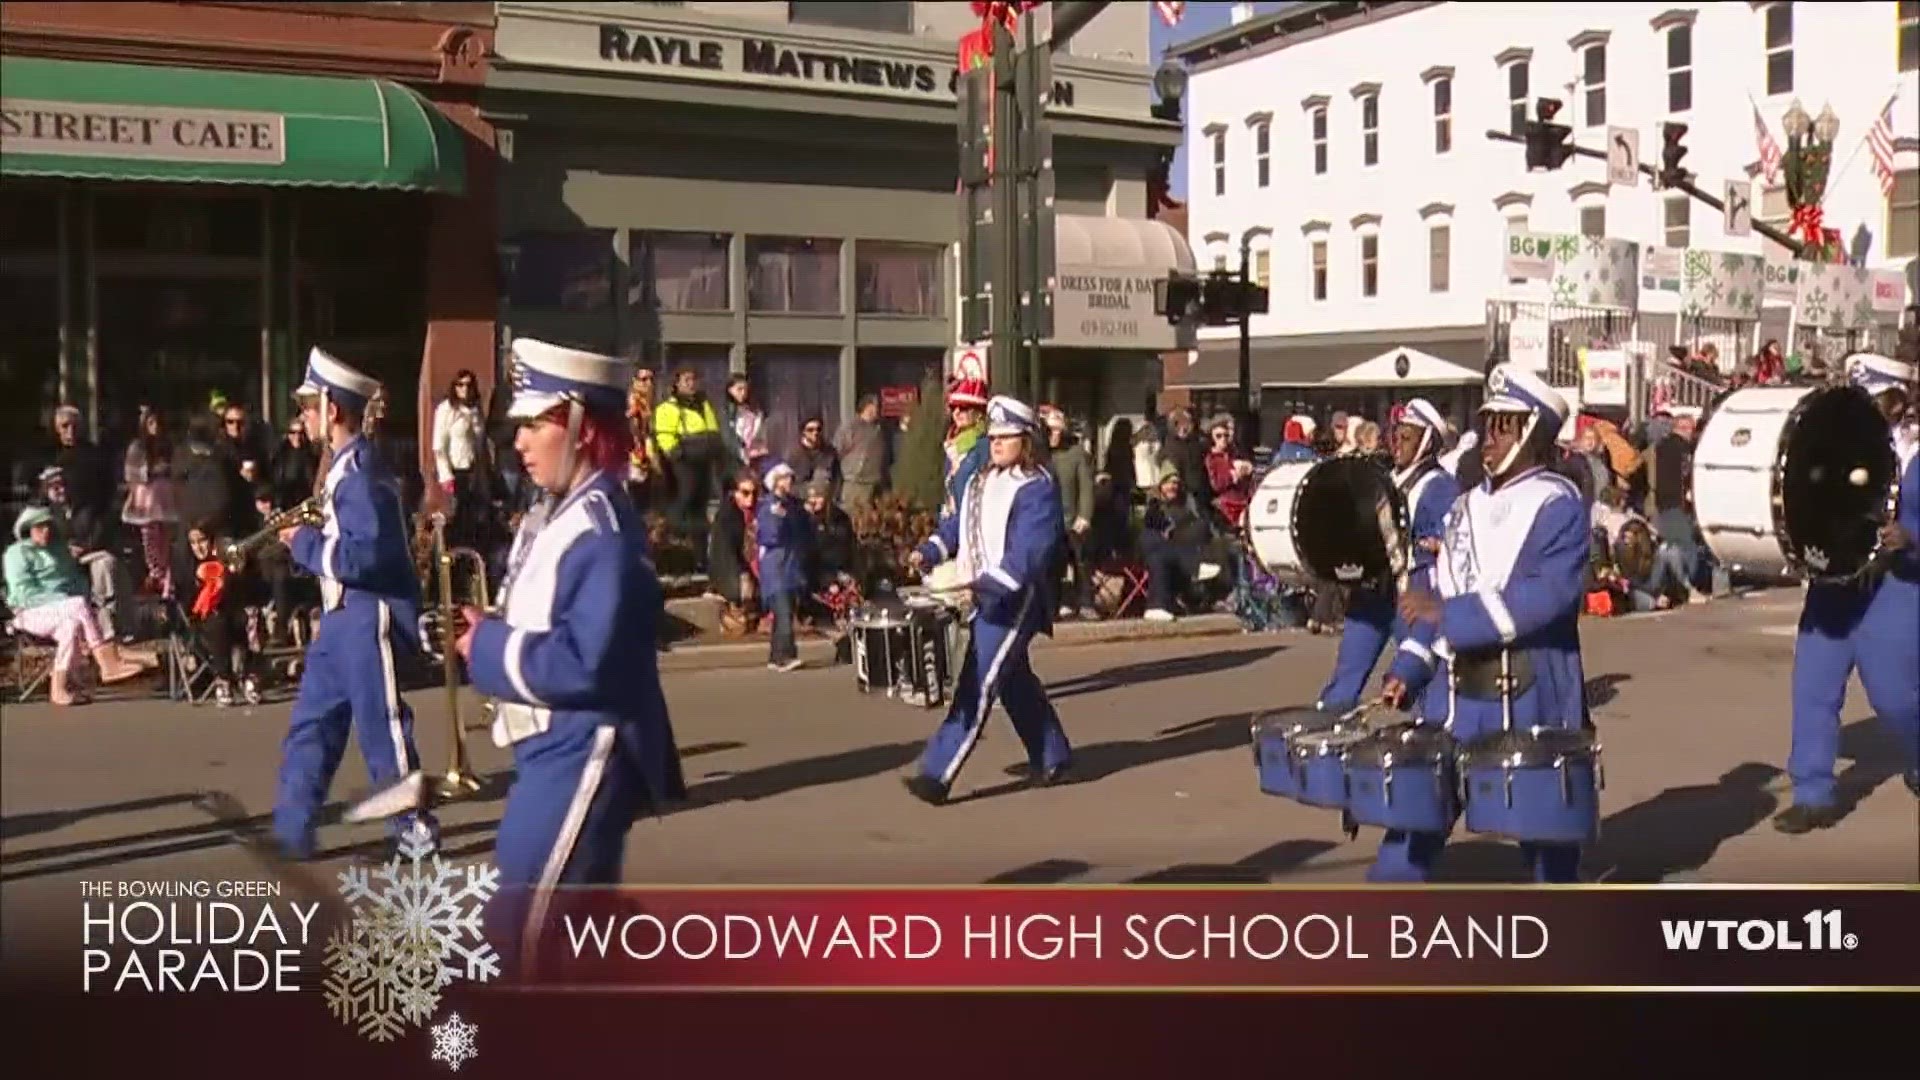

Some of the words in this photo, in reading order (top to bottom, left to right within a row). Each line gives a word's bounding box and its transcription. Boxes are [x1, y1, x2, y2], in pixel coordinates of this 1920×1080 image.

[599, 23, 723, 72] RAYLE
[742, 38, 936, 93] MATTHEWS
[1, 109, 160, 146] STREET
[172, 118, 273, 150] CAFE
[1125, 278, 1133, 294] A
